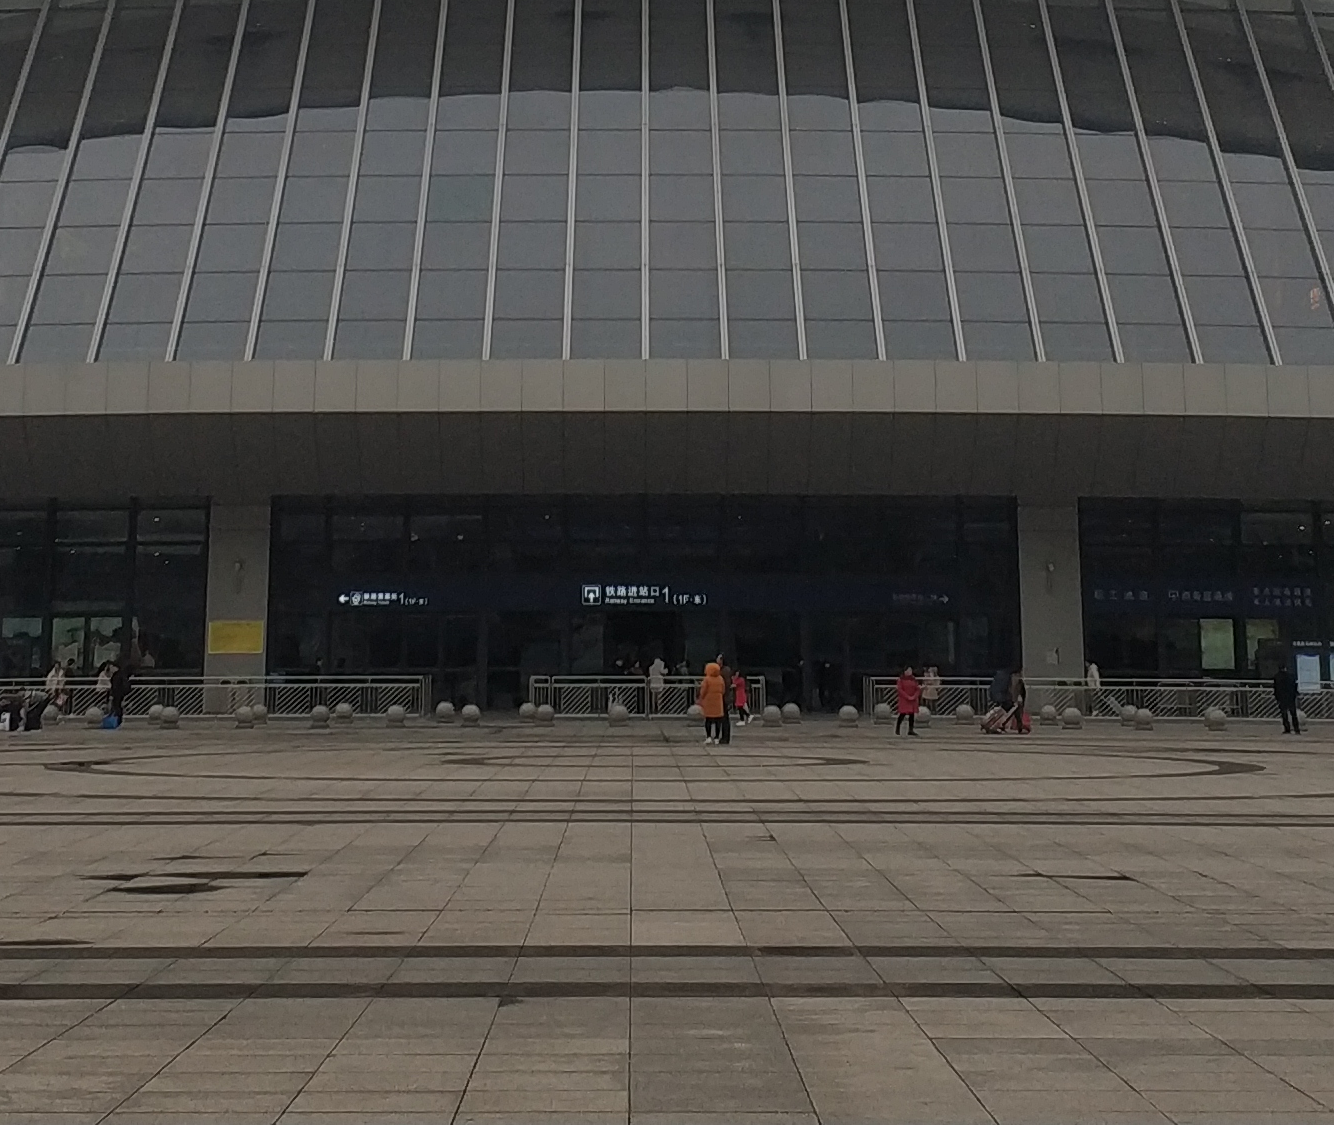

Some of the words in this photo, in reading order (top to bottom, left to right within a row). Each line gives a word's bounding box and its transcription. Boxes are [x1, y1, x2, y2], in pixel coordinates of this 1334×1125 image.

[605, 585, 660, 597] 铁路进站口
